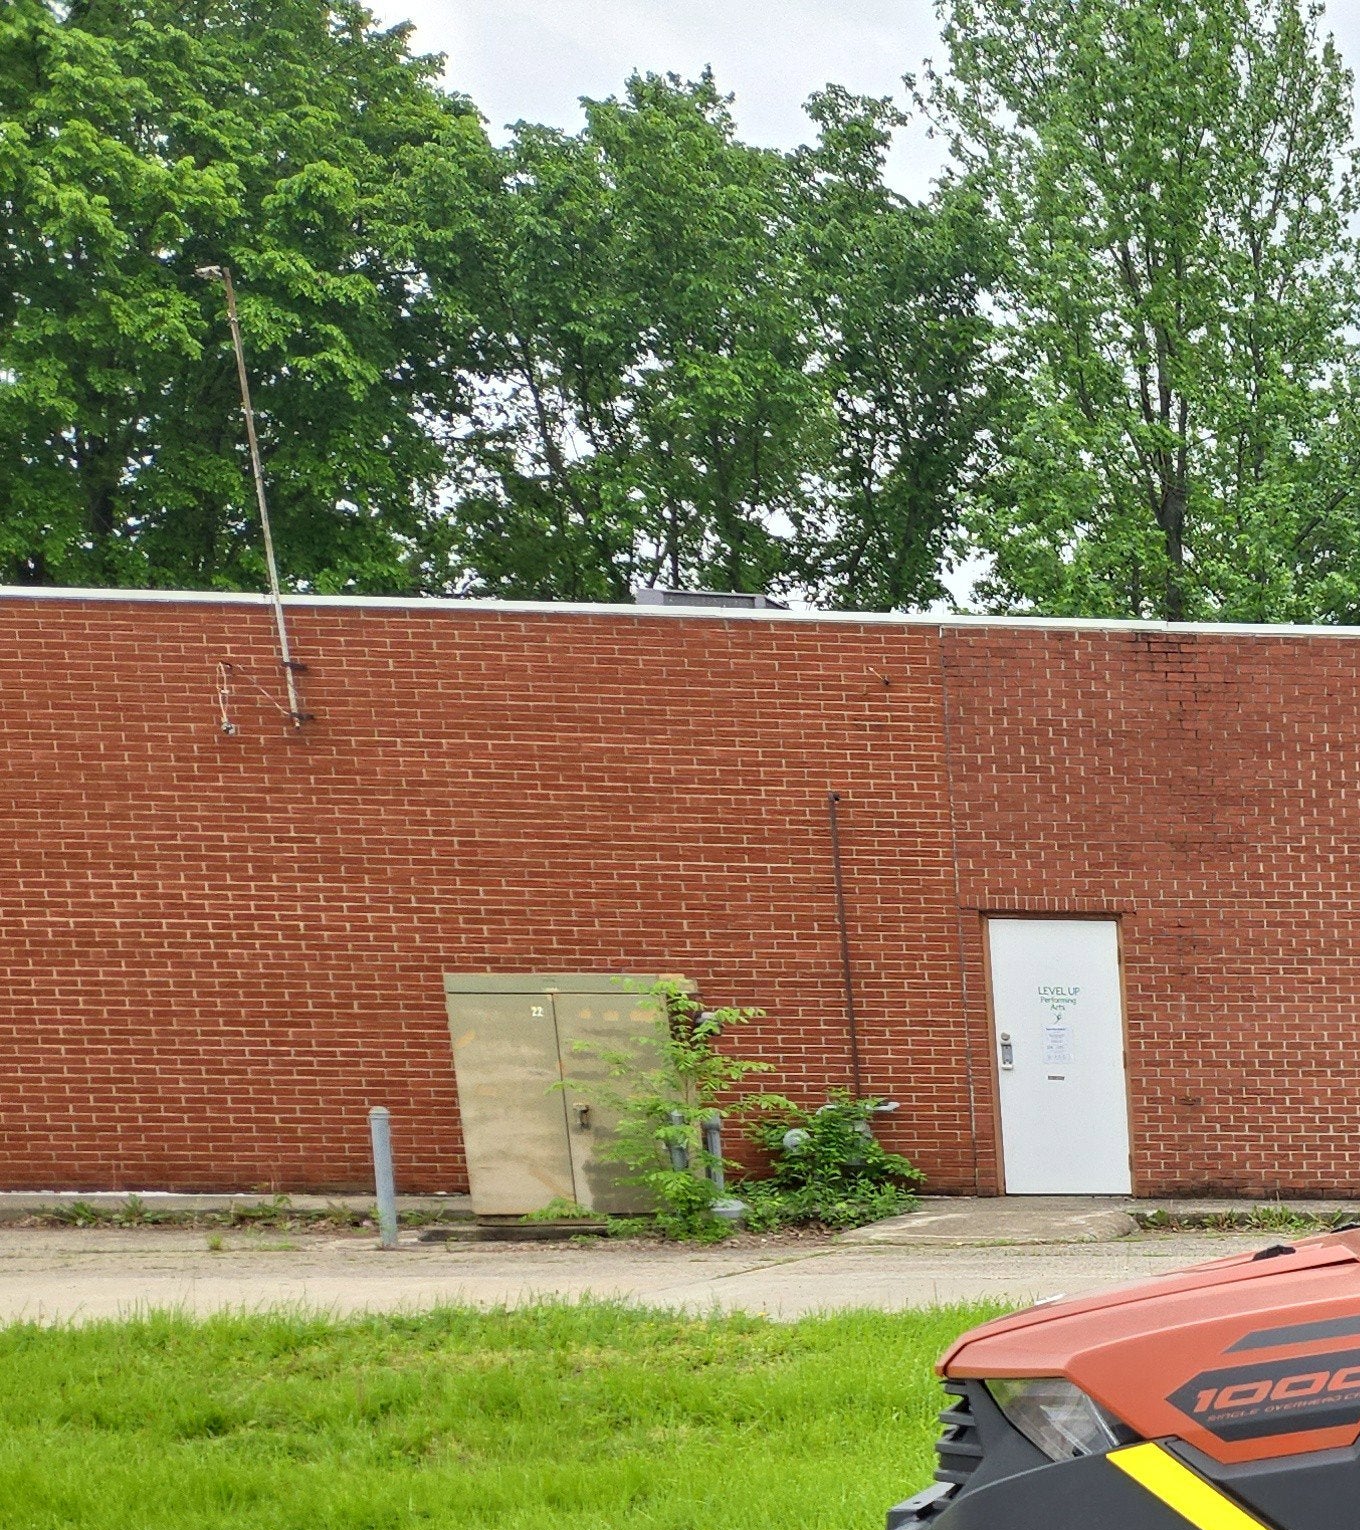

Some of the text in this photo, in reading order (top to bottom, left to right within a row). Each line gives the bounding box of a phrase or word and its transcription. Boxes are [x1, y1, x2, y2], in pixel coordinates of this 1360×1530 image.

[1037, 986, 1081, 996] LEVEL UP
[1040, 995, 1077, 1005] Performing
